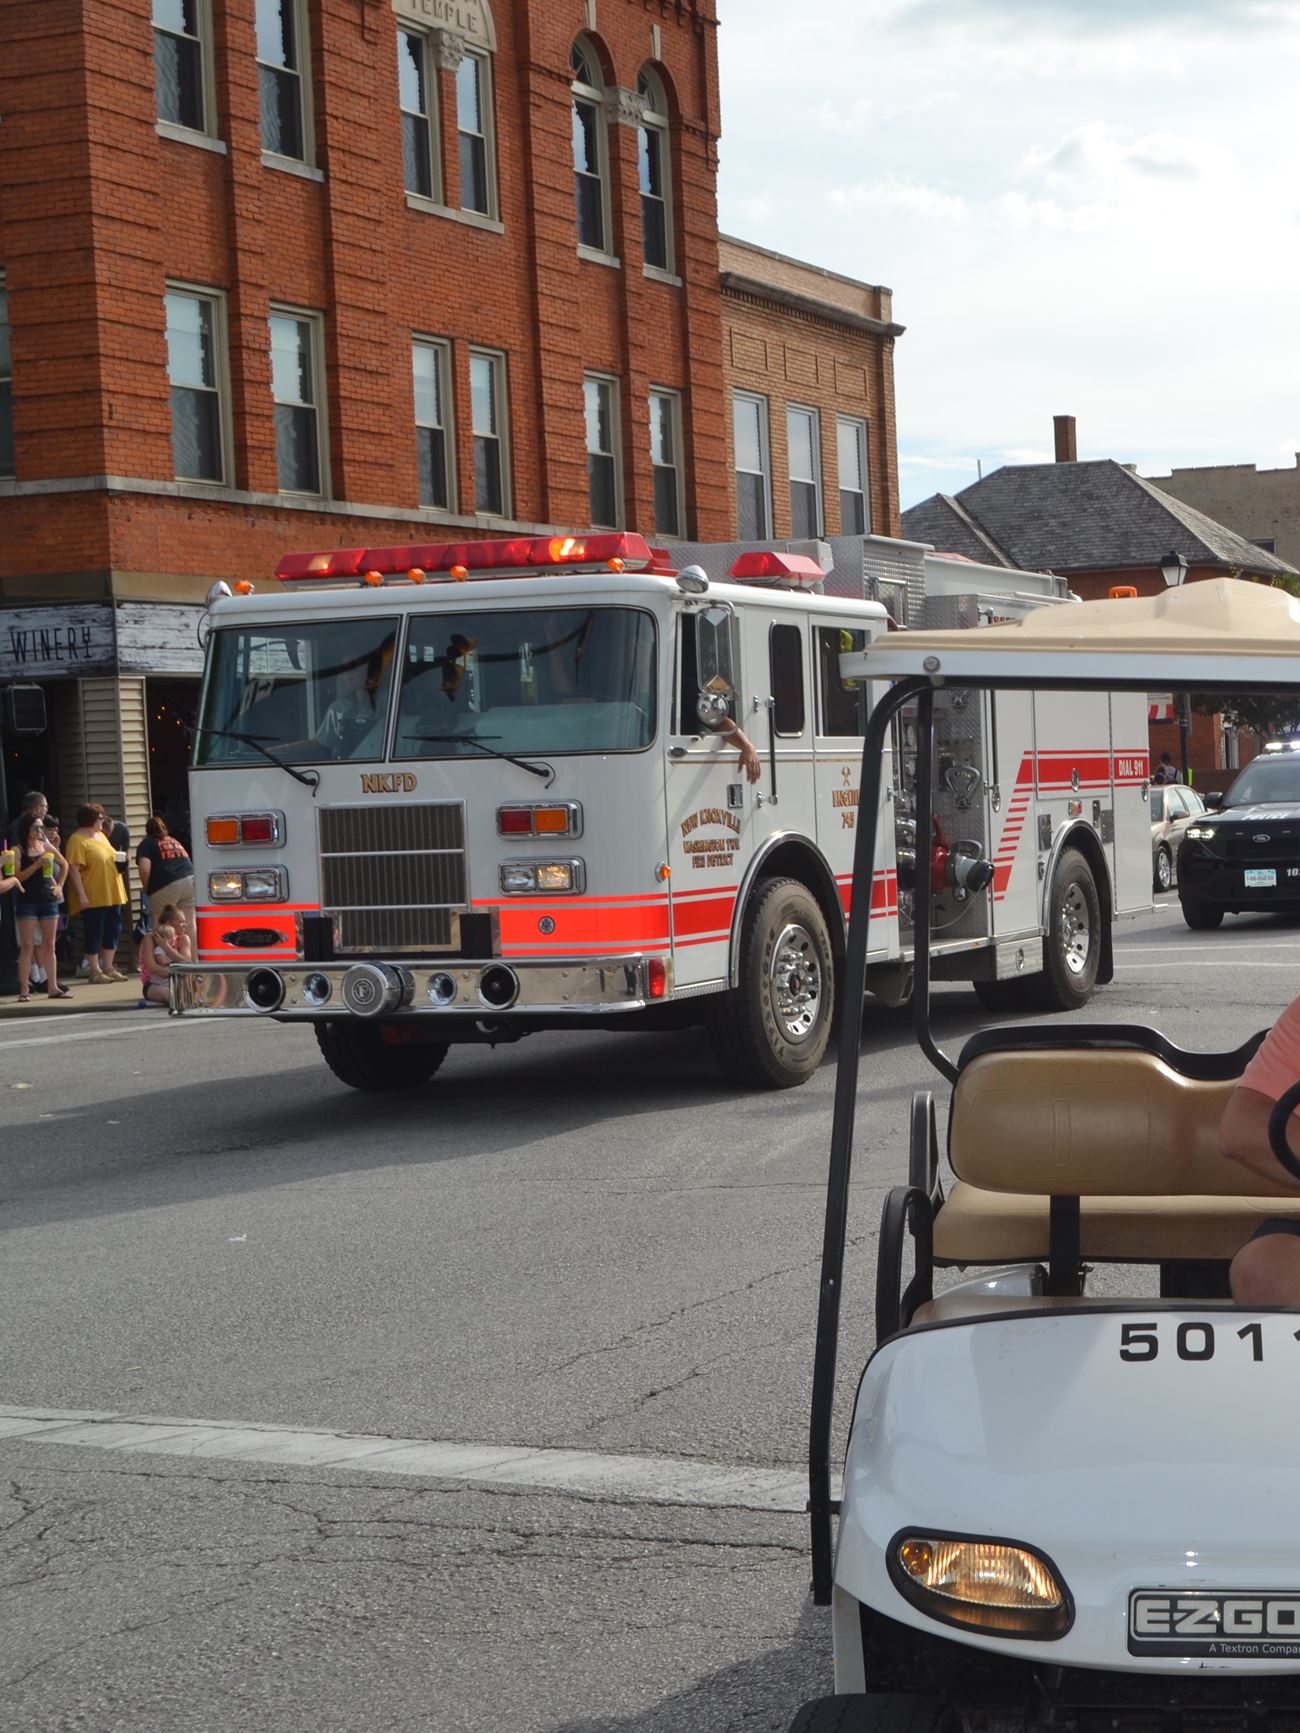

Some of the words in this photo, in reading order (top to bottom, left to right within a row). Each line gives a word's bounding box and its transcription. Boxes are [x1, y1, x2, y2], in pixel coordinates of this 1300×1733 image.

[10, 626, 93, 664] WINERY
[1119, 759, 1133, 776] DIAL
[1134, 759, 1144, 776] 911
[360, 772, 417, 793] NKFD
[681, 812, 698, 838] NEW
[1209, 1643, 1217, 1653] A
[1220, 1643, 1259, 1653] Textron
